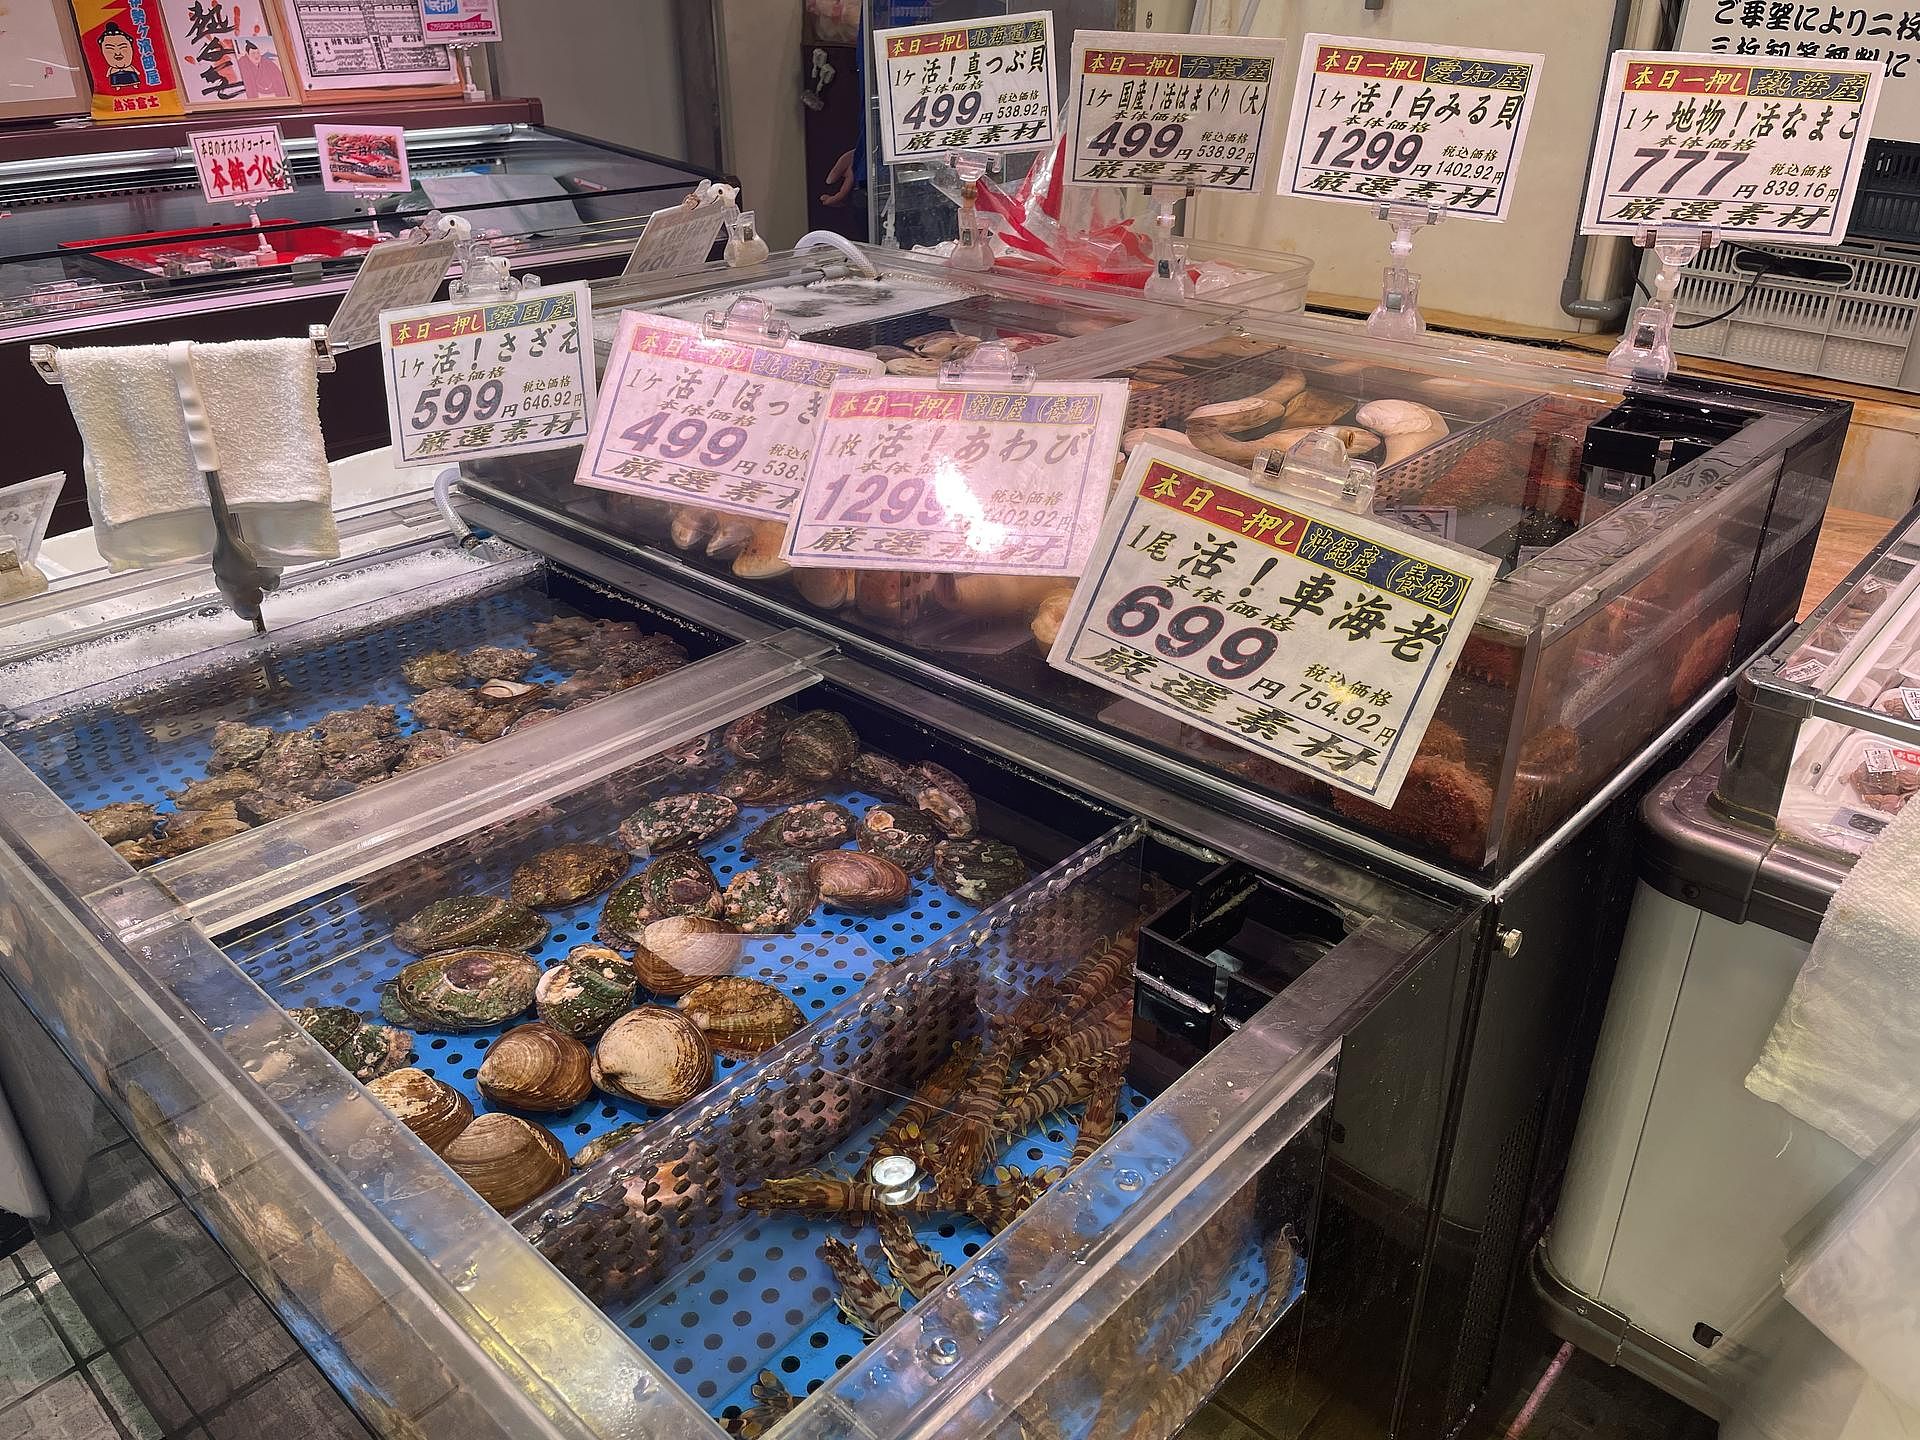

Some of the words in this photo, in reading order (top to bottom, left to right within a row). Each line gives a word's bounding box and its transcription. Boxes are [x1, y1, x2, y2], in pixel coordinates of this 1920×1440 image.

[891, 35, 966, 57] 本日一押し
[969, 21, 1045, 47] 北海道産
[922, 44, 1046, 84] 活！真つぶ貝
[1089, 54, 1177, 76] 本日一押し
[1182, 57, 1271, 82] 千葉産
[1322, 51, 1420, 80] 本日一押し
[1425, 60, 1529, 90] 愛知産
[919, 80, 984, 95] 本体価格
[998, 90, 1039, 104] 税込価格
[1631, 66, 1745, 94] 本日一押し
[1751, 71, 1864, 101] 熱海産
[1112, 111, 1189, 122] 本体価格
[1350, 82, 1525, 131] 活！白みる貝
[902, 121, 1047, 151] 厳選素材
[1201, 132, 1249, 144] 税込価格
[1343, 115, 1431, 133] 本体価格
[1443, 145, 1498, 162] 税込価格
[1655, 136, 1758, 151] 本体価格
[1082, 160, 1250, 185] 厳選素材
[1770, 163, 1833, 179] 税込価格
[1303, 171, 1497, 209] 厳選素材
[1608, 198, 1830, 230] 厳選素材
[396, 314, 482, 344] 本日一押し
[488, 297, 574, 329] 韓国産
[431, 321, 579, 376] 活！さざえ
[640, 331, 745, 369] 本日一押し
[753, 353, 870, 386] 北海道
[429, 366, 505, 388] 本体価格
[522, 376, 571, 394] 税込価格
[656, 399, 756, 428] 本体価格
[838, 394, 959, 419] 本日一押し
[410, 411, 583, 456] 厳選素材
[868, 424, 1093, 465] 活！あわび
[762, 461, 805, 482] 538.
[1149, 473, 1296, 547] 本日一押し
[1301, 528, 1465, 609] 沖縄産（養殖）
[1162, 573, 1297, 633] 本体価格
[1179, 533, 1449, 663] 活！車海老
[1305, 663, 1395, 708] 税込価格
[1080, 646, 1380, 774] 厳選素材
